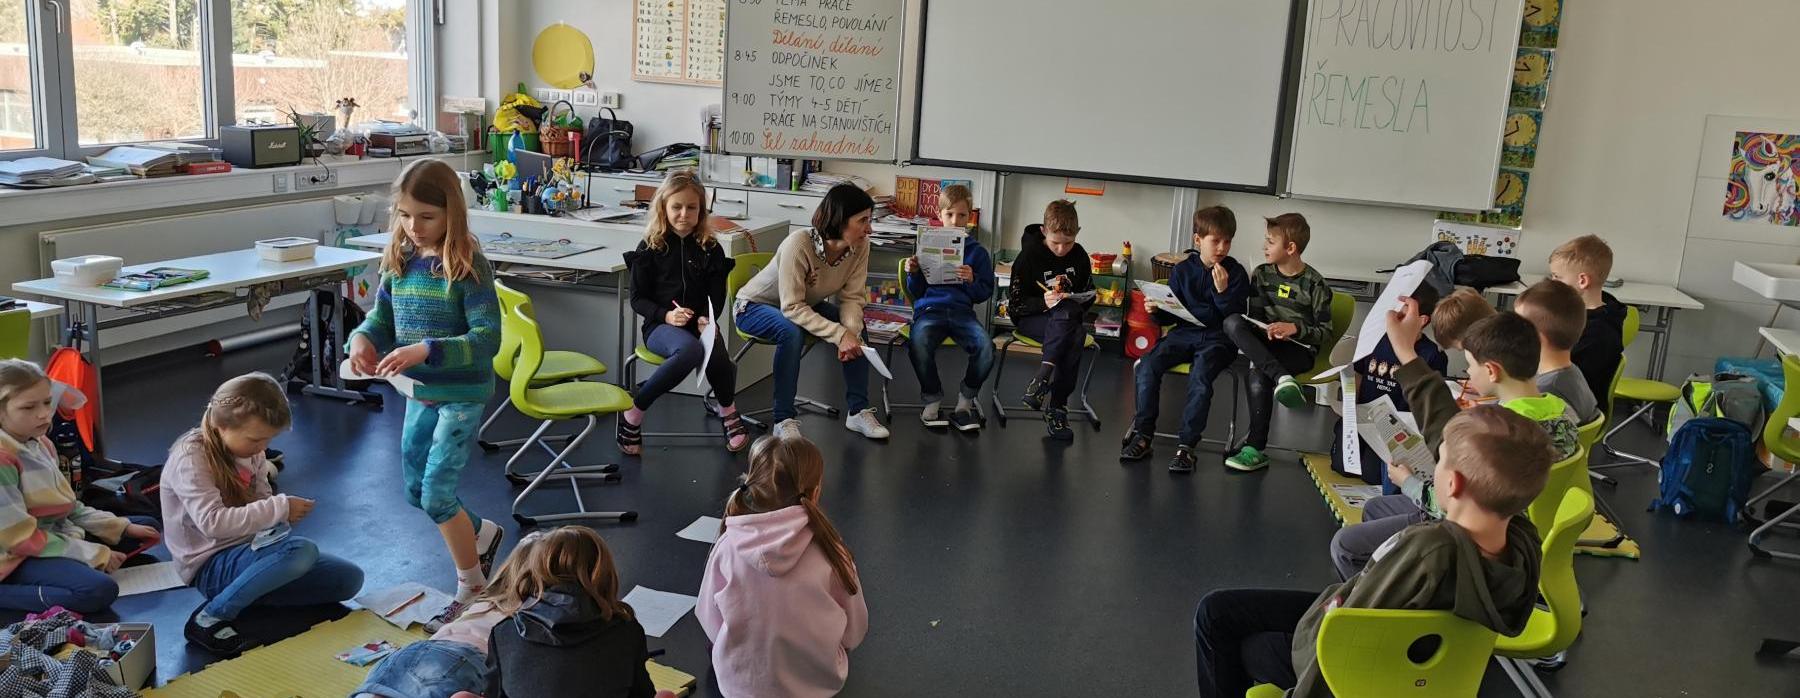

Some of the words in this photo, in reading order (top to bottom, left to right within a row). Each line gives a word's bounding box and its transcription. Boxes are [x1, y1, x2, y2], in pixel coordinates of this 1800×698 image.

[831, 13, 893, 32] POVOLÁNÍ
[772, 51, 839, 70] ODPOČINEK
[769, 73, 800, 88] JSME
[769, 90, 803, 109] TÝMY
[836, 97, 869, 114] DĚTÍ
[1307, 58, 1430, 133] ŘEMESLA
[763, 109, 796, 127] PRÁCE
[802, 114, 817, 128] NA
[820, 113, 892, 134] STANOVIŠTÍCH
[789, 131, 880, 156] zahradník
